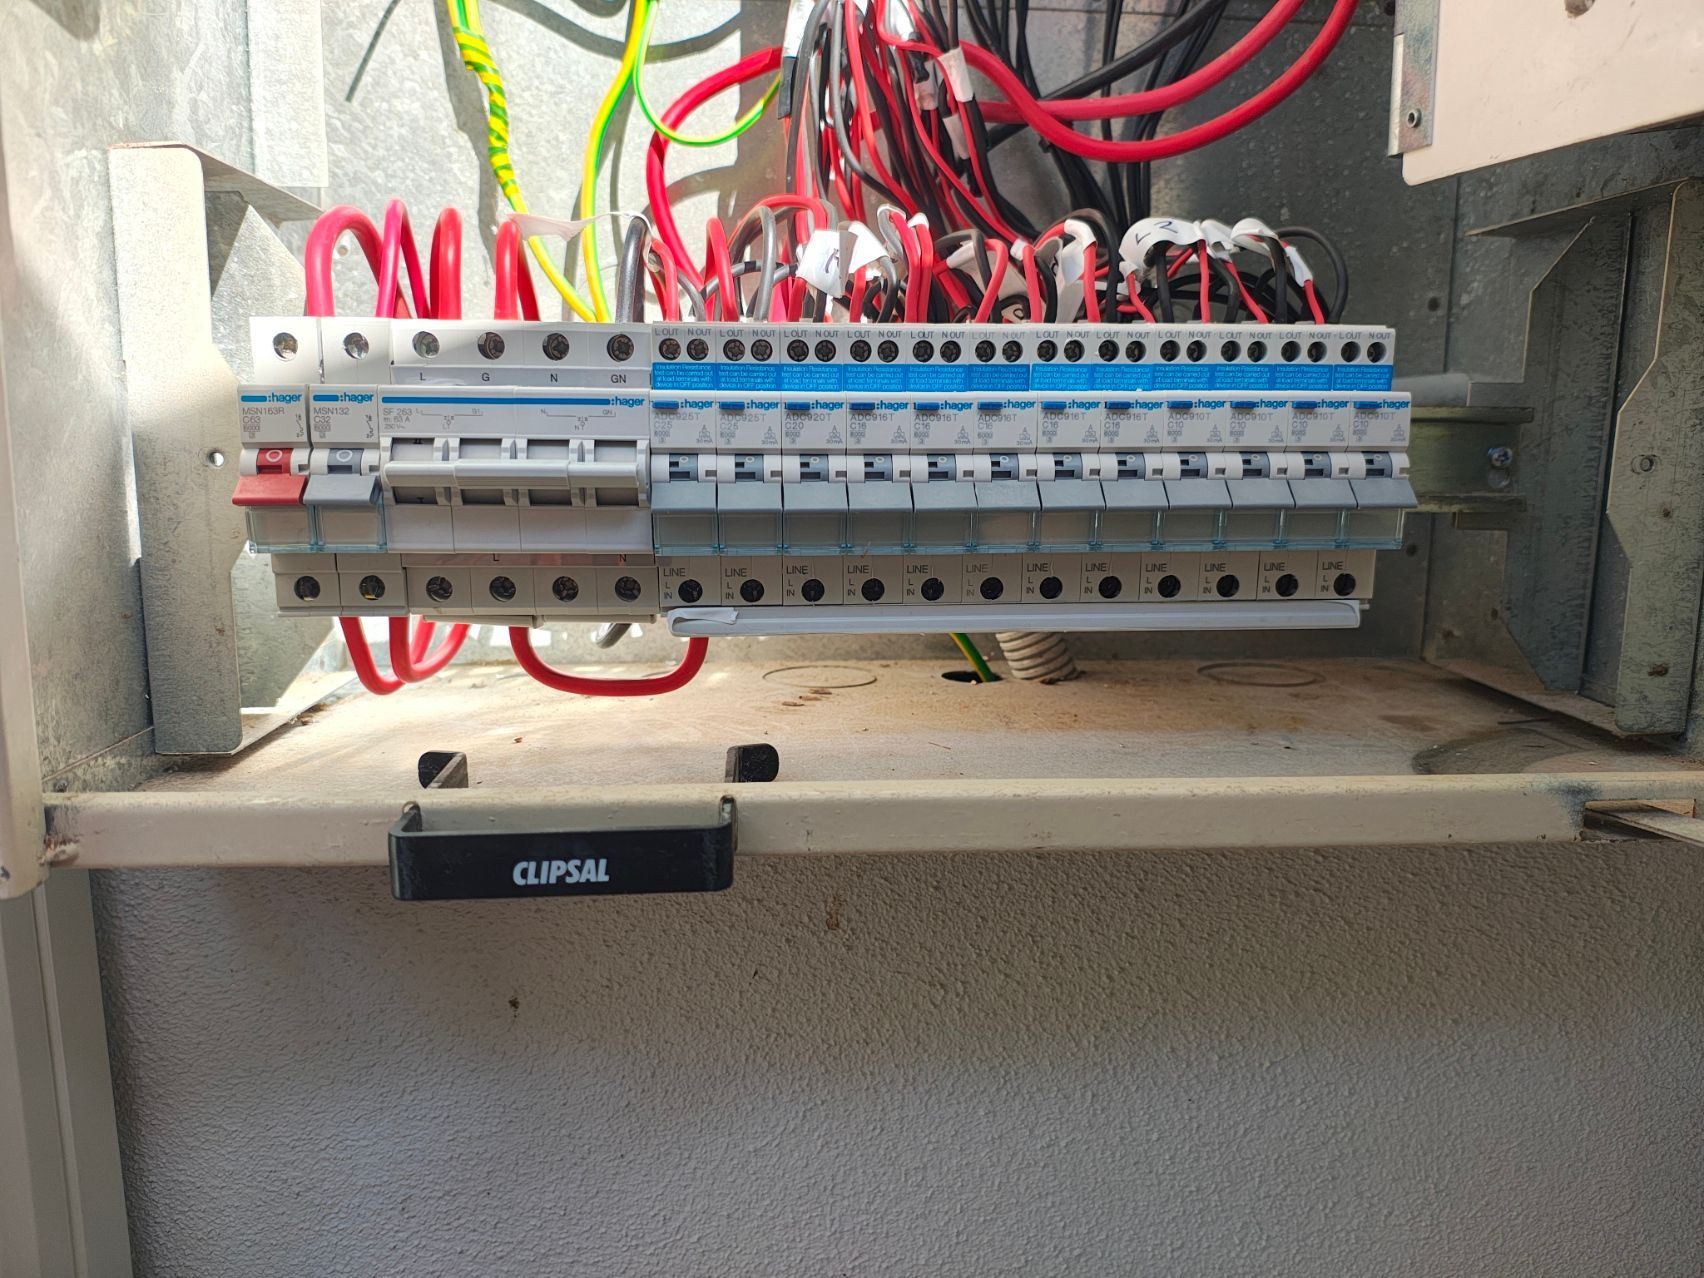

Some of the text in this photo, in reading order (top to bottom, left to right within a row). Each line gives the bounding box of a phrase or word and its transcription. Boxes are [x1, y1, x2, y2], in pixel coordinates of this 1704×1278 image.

[655, 328, 678, 336] L OUT
[688, 328, 711, 336] N OUT
[420, 372, 426, 380] L
[481, 373, 490, 381] G
[550, 374, 558, 382] N
[610, 374, 626, 384] GN
[314, 416, 331, 424] C32
[493, 554, 500, 562] L
[619, 553, 627, 562] N
[848, 565, 869, 574] LINE
[907, 565, 928, 574] LINE
[966, 564, 988, 573] LINE
[1027, 563, 1048, 572] LINE
[1086, 563, 1107, 572] LINE
[1146, 563, 1167, 572] LINE
[1204, 563, 1226, 572] LINE
[1264, 562, 1285, 571] LINE
[1322, 561, 1343, 570] LINE
[664, 568, 685, 577] LINE
[725, 568, 747, 577] LINE
[787, 566, 808, 575] LINE
[787, 589, 795, 597] IN
[967, 589, 974, 597] IN
[1084, 586, 1093, 594] IN
[512, 858, 610, 886] CLIPSAL
